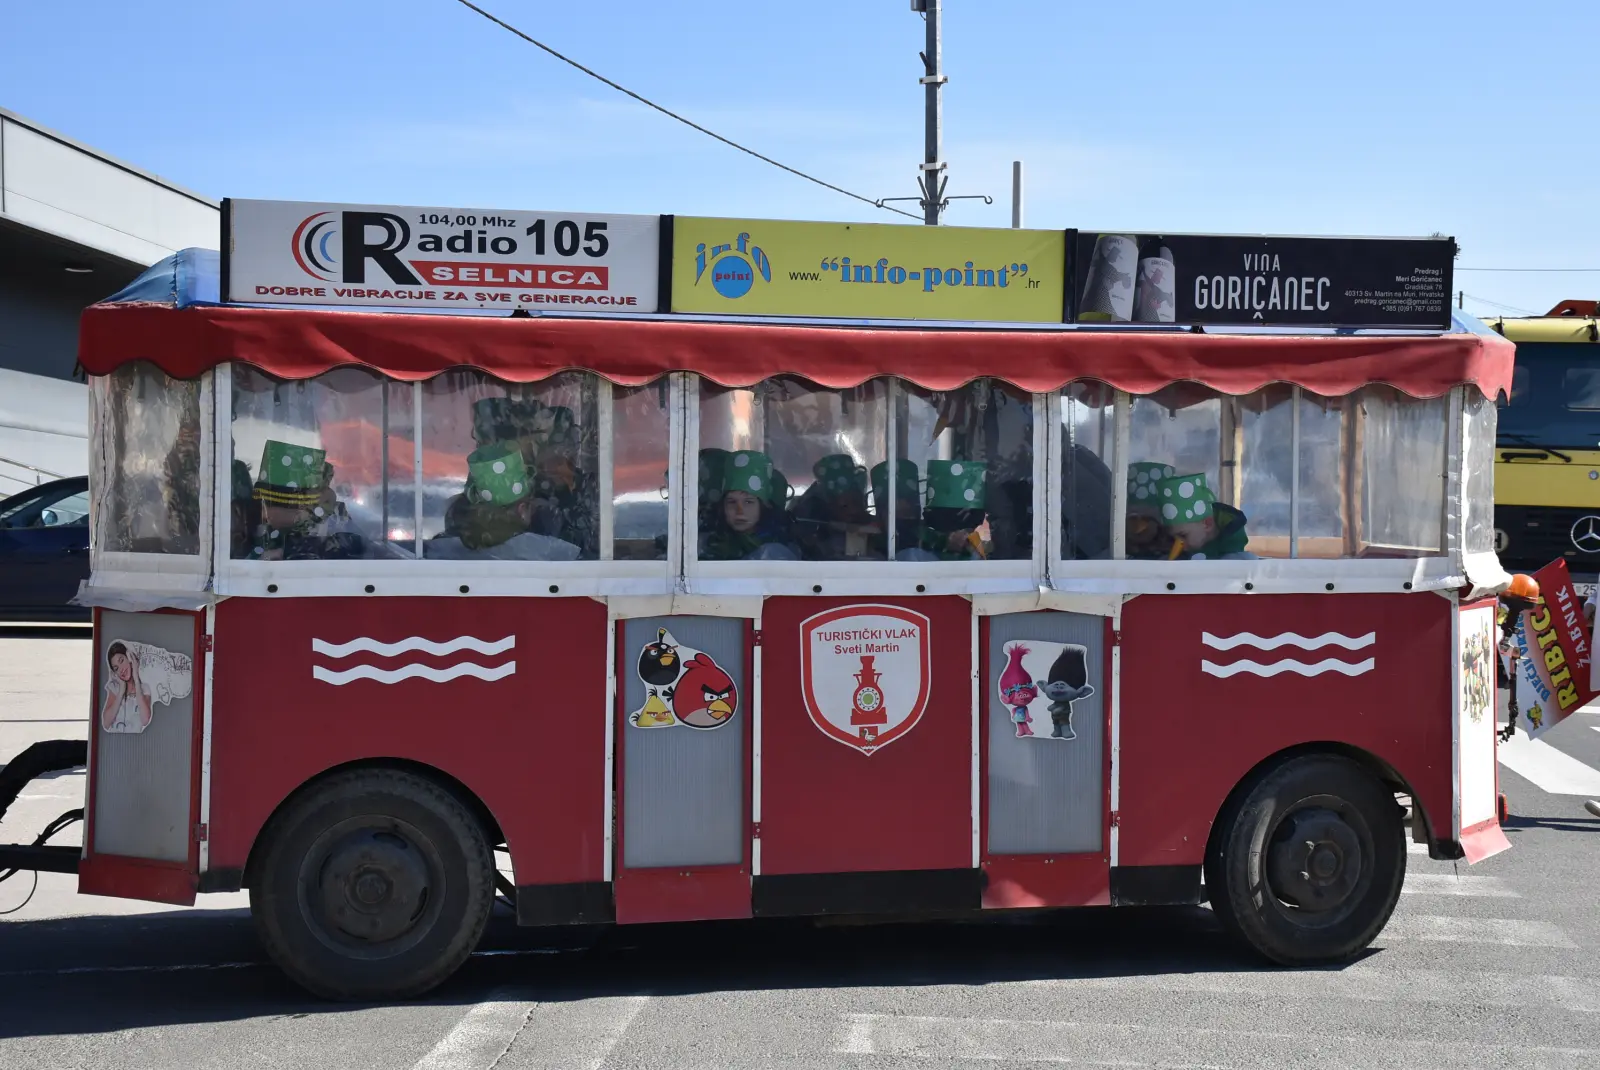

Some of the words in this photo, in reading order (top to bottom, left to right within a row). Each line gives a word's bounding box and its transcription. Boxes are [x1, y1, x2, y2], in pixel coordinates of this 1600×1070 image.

[419, 213, 476, 228] 104,00
[482, 216, 517, 229] Mhz
[526, 219, 610, 258] 105
[694, 232, 772, 286] info
[431, 266, 604, 286] SELNICA
[714, 271, 751, 282] point
[255, 285, 327, 298] DOBRE
[333, 287, 437, 301] VIBRACIJE
[443, 290, 469, 301] ZA
[474, 291, 512, 303] SVE
[518, 293, 638, 306] GENERACIJE
[816, 627, 882, 642] TURISTIČKI
[884, 628, 916, 639] VLAK
[1556, 585, 1591, 669] ŽABNIK
[834, 644, 862, 655] Sveti
[865, 642, 900, 653] Martin
